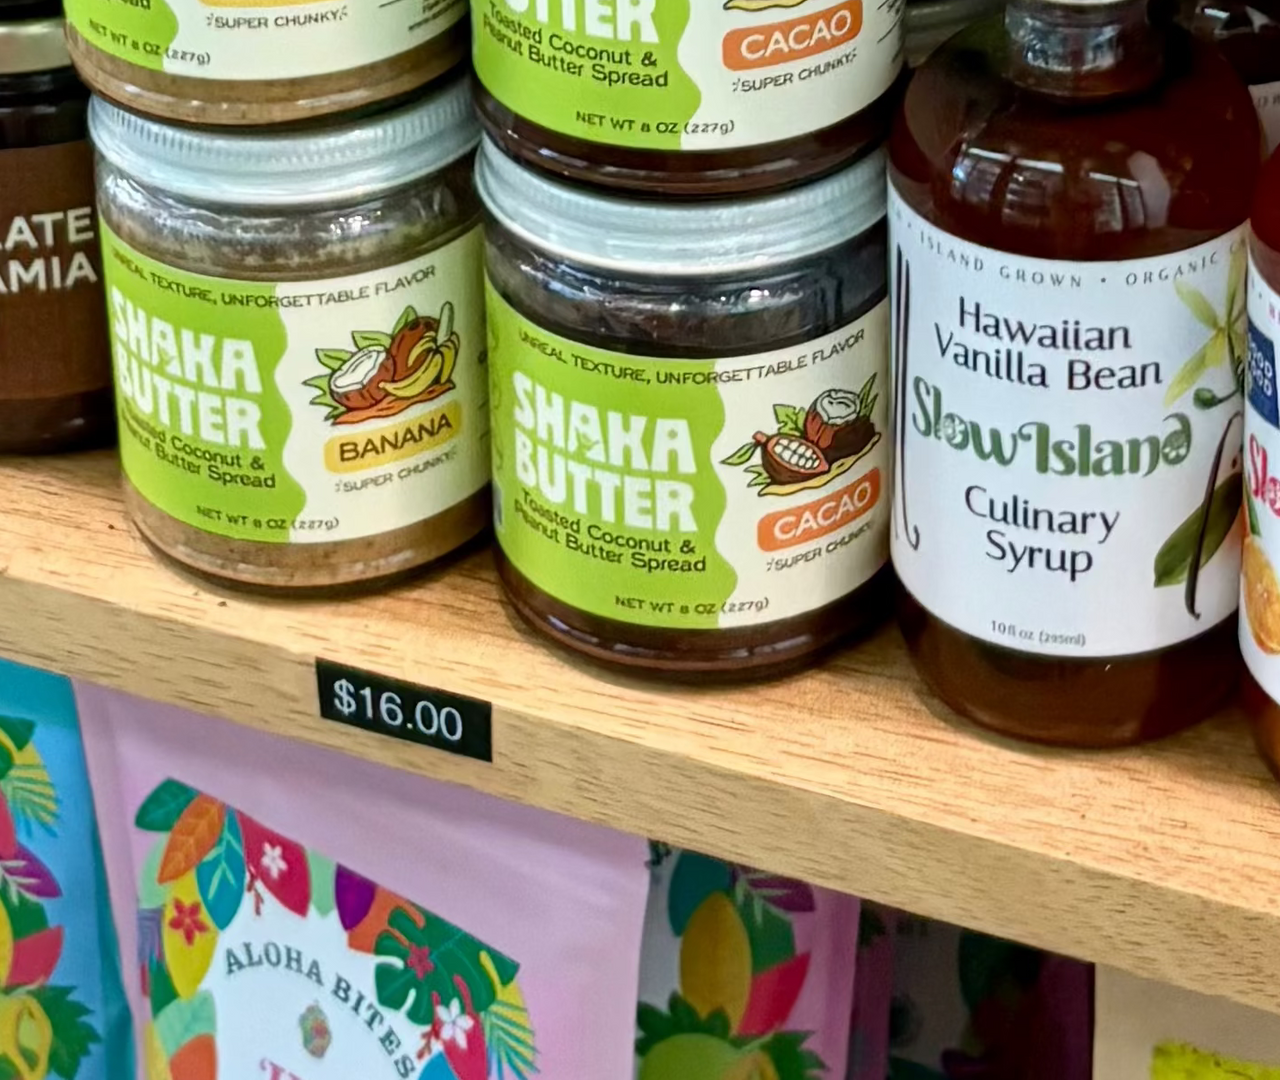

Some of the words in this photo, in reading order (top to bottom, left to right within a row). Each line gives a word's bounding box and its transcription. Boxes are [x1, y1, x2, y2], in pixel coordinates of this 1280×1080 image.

[214, 14, 269, 30] SUPER
[274, 7, 338, 27] CHUNKY
[489, 0, 543, 45] Toasted
[549, 33, 632, 67] Coconut
[641, 51, 657, 67] &
[740, 9, 852, 62] CACAO
[143, 41, 162, 56] OZ
[528, 43, 584, 78] Butter
[591, 60, 669, 89] Spread
[741, 72, 794, 93] SUPER
[798, 51, 851, 81] CHUNKY
[576, 110, 606, 128] NET
[610, 118, 635, 133] WT
[656, 120, 679, 134] OZ
[684, 120, 735, 136] (227g)
[920, 232, 985, 273] ISLAND
[999, 265, 1083, 289] GROWN
[1125, 251, 1219, 287] ORGANIC
[150, 270, 217, 305] TEXTURE,
[221, 286, 371, 309] UNFORGETTABLE
[375, 265, 436, 294] FLAVOR
[111, 283, 263, 395] SHAKA
[959, 295, 1132, 351] Hawaiian
[571, 353, 651, 385] TEXTURE,
[656, 354, 808, 385] UNFORGETTABLE
[812, 328, 865, 365] FLAVOR
[933, 322, 1049, 388] Vanilla
[1067, 359, 1162, 392] Bean
[116, 340, 267, 451] BUTTER
[339, 412, 452, 463] BANANA
[512, 370, 696, 475] SHAKA
[155, 441, 201, 475] Butter
[208, 463, 276, 490] Spread
[171, 434, 242, 469] Coconut
[250, 455, 265, 471] &
[342, 471, 393, 492] SUPER
[514, 427, 698, 533] BUTTER
[196, 504, 222, 520] NET
[227, 513, 249, 526] WT
[267, 517, 287, 530] OZ
[291, 516, 339, 531] (227g)
[522, 488, 581, 535] Toasted
[587, 522, 671, 554] Coconut
[680, 538, 696, 555] &
[773, 480, 873, 542] CACAO
[964, 485, 1120, 544] Culinary
[566, 533, 624, 567] Butter
[631, 550, 707, 574] Spread
[775, 549, 822, 572] SUPER
[985, 530, 1095, 582] Syrup
[615, 595, 646, 609] NET
[651, 602, 675, 613] WT
[680, 604, 690, 614] 8
[694, 602, 717, 615] OZ
[721, 596, 769, 615] (227g)
[333, 678, 463, 741] $16.00
[224, 940, 325, 988] ALOHA
[331, 973, 418, 1079] BITES
